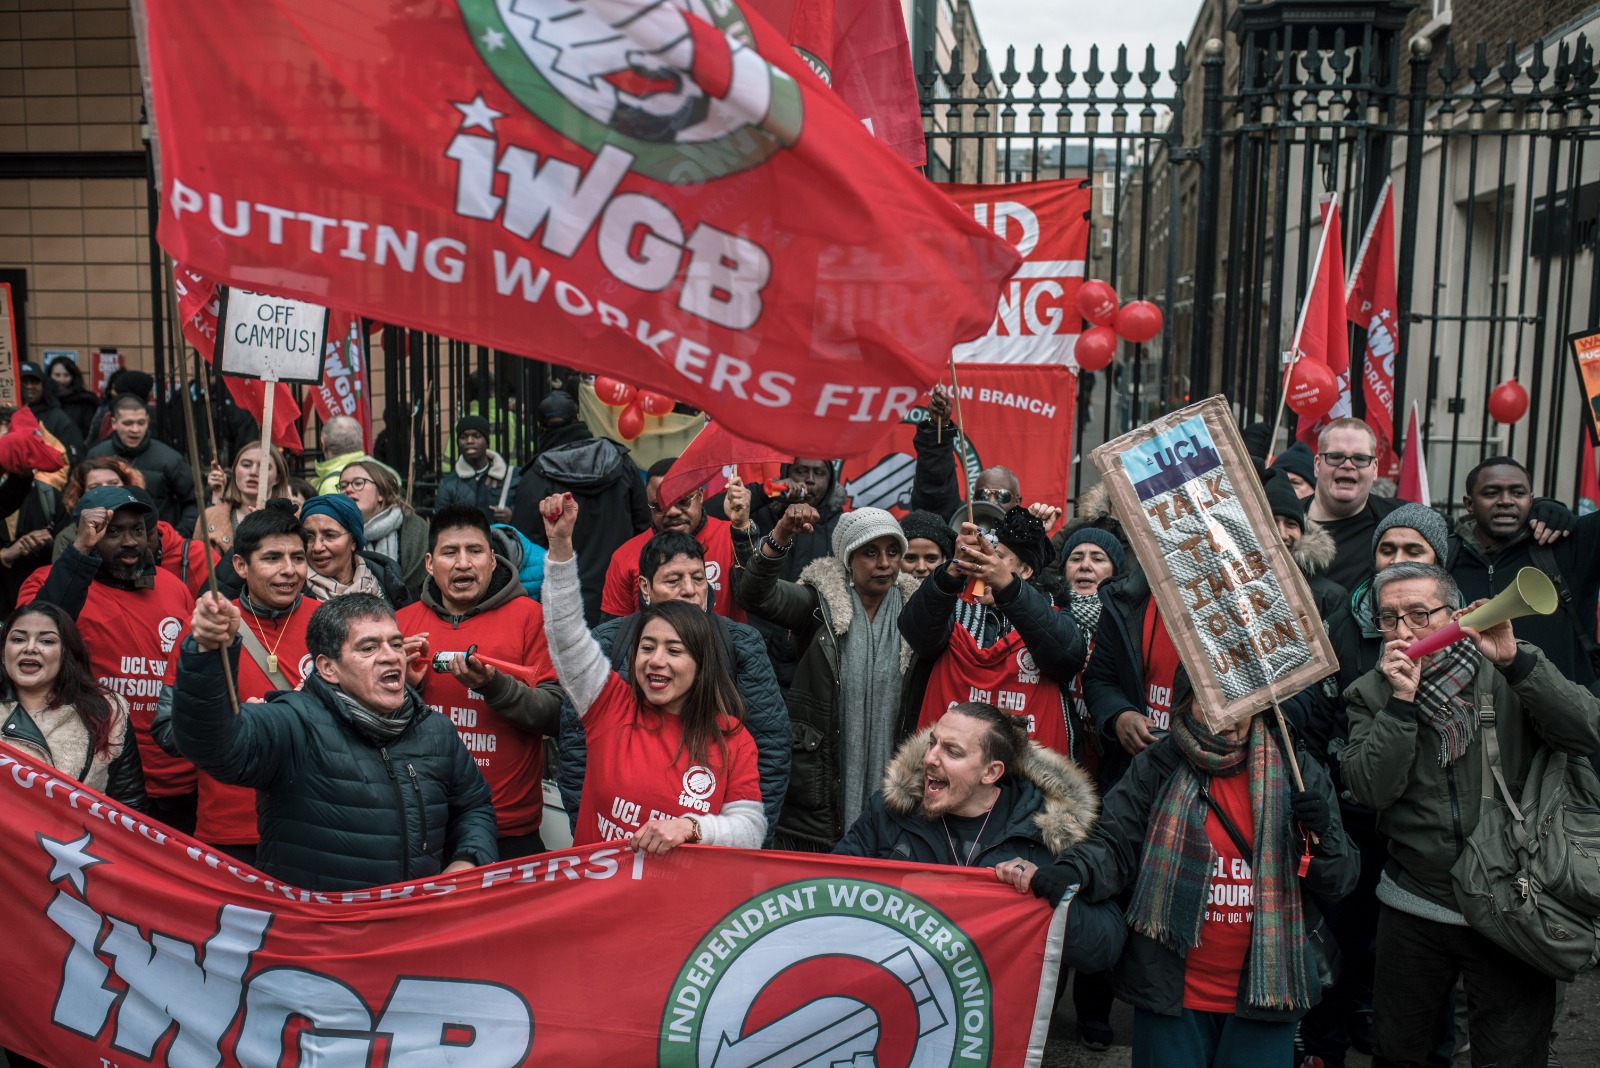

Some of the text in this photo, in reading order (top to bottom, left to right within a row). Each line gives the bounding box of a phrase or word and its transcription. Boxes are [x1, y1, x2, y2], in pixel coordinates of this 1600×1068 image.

[170, 178, 467, 284] PUTTING
[257, 303, 295, 326] OFF
[234, 322, 316, 356] CAMPUS!
[978, 388, 1057, 420] BRANCH
[1153, 434, 1209, 473] UCL
[1147, 474, 1232, 531] TALK
[1184, 550, 1267, 612] IWGB
[1207, 589, 1272, 637] OUR
[121, 656, 149, 675] UCL
[998, 690, 1027, 711] END
[1149, 683, 1171, 708] UCL
[450, 706, 478, 728] END
[611, 796, 642, 828] UCL
[1213, 911, 1225, 922] for
[1227, 912, 1243, 924] UCL
[667, 884, 985, 1061] INDEPENDENT WORKERS UNION
